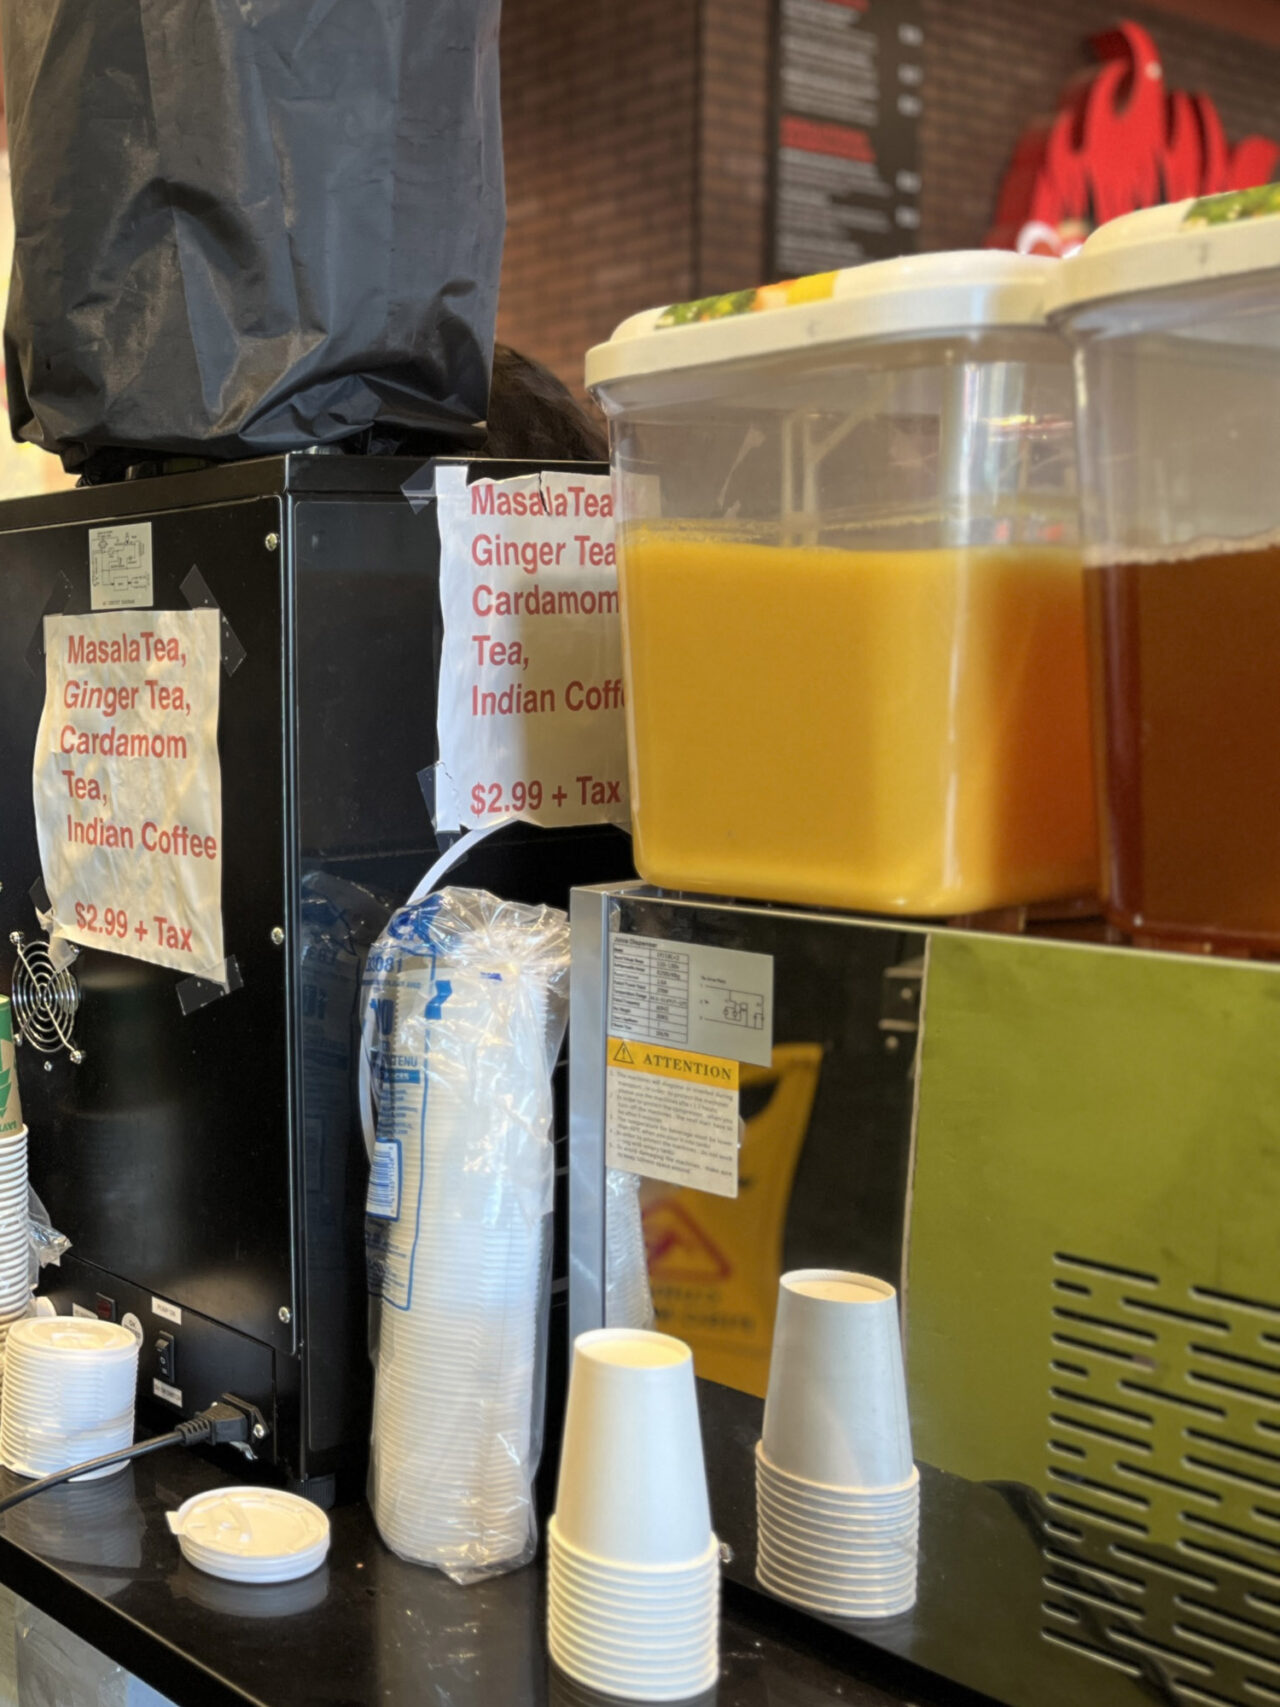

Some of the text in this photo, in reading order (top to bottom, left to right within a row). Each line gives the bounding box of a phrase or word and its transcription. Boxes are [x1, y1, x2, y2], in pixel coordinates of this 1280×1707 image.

[471, 533, 566, 575] Ginger
[472, 584, 619, 618] Cardamom
[472, 635, 530, 671] Tea,
[63, 679, 191, 717] Ginger Tea,
[471, 679, 626, 716] Indian Coff
[59, 724, 187, 760] Cardamom
[62, 770, 107, 805] Tea,
[470, 775, 621, 818] $2.99 + Tax
[67, 814, 218, 861] Indian Coffee
[75, 900, 193, 953] $2.99 + Tax
[642, 1053, 732, 1081] ATTENTION
